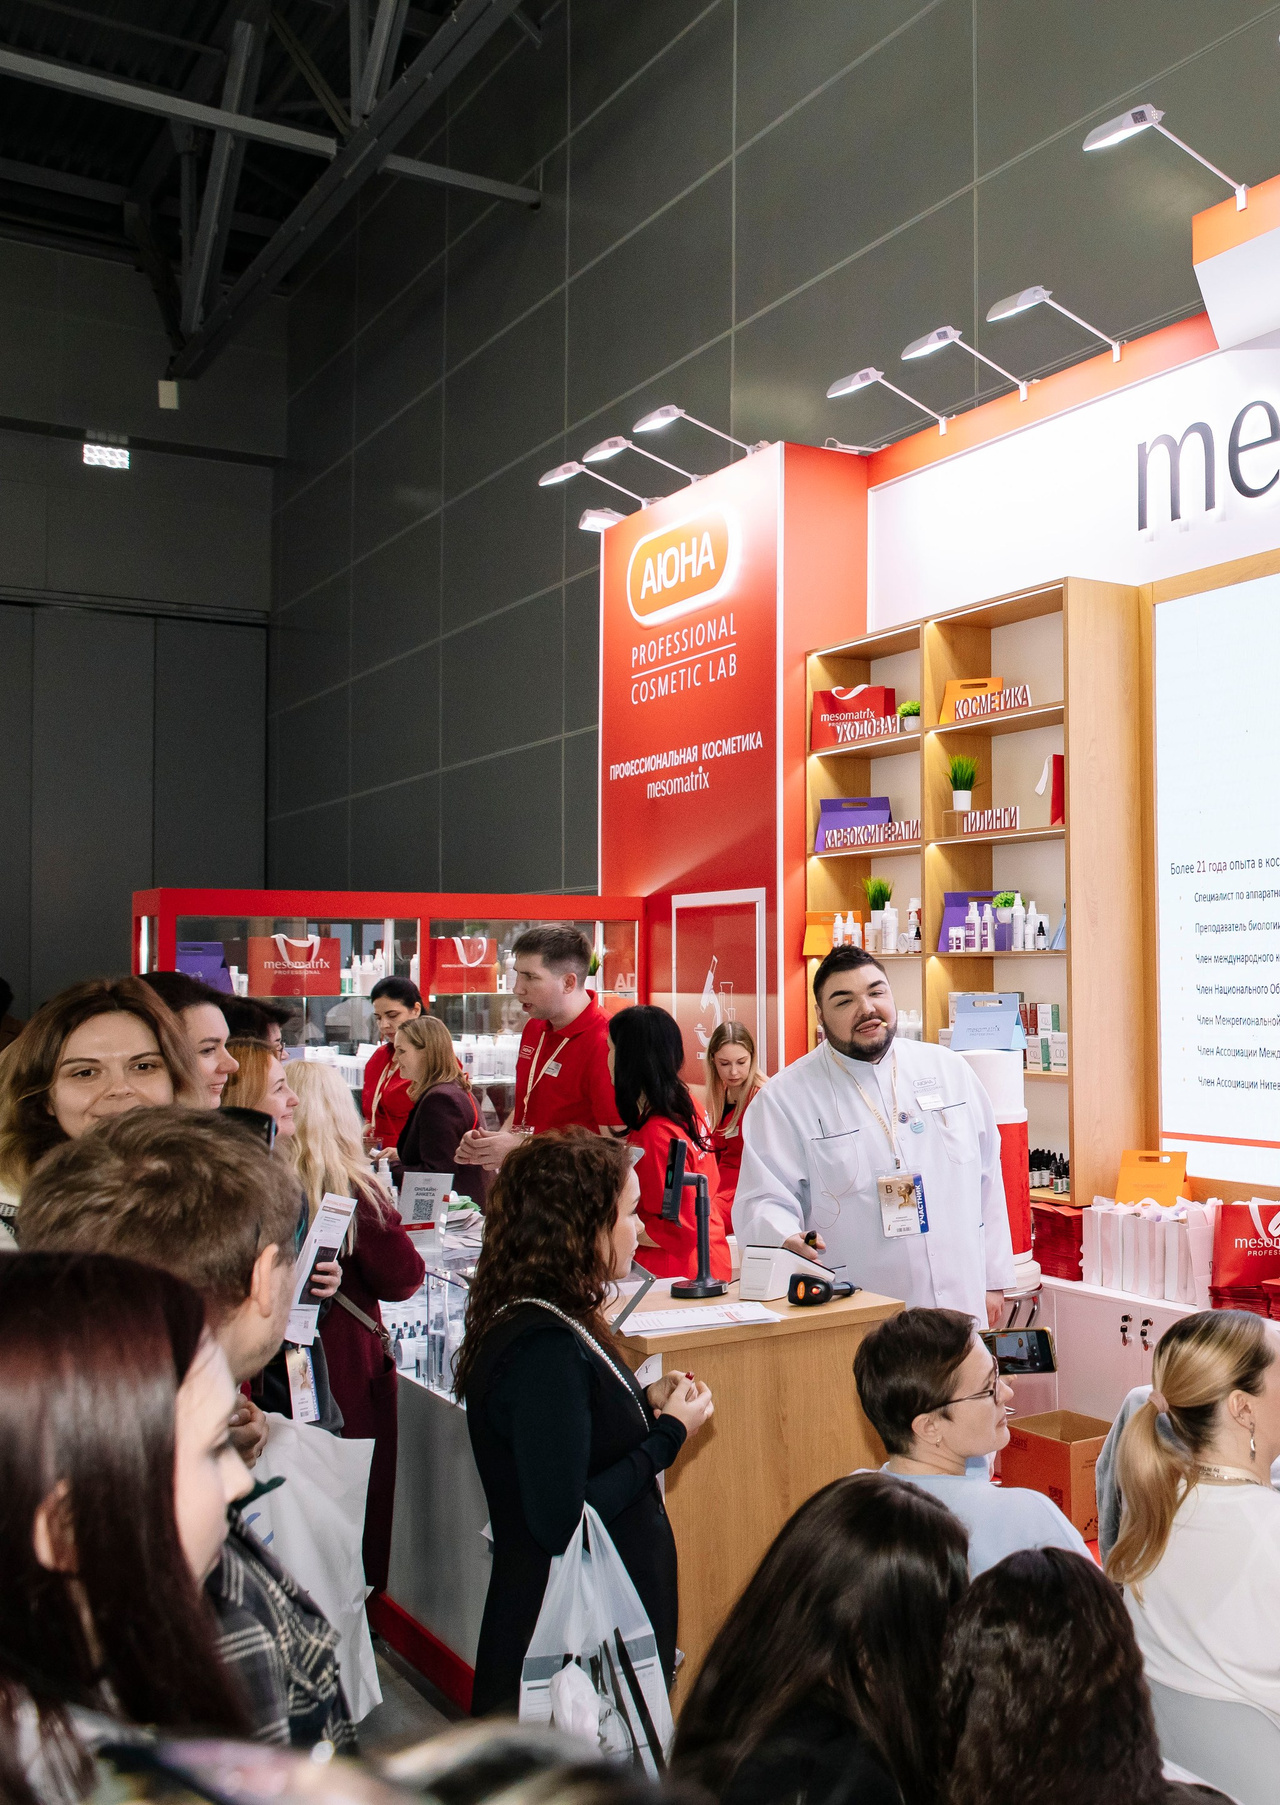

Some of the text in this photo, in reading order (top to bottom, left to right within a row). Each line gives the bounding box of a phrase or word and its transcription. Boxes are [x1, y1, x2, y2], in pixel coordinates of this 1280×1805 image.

[640, 531, 716, 600] АЮНА
[631, 612, 738, 669] PROFESSIONAL
[631, 653, 738, 705] COSMETIC LAB
[955, 684, 1032, 721] КОСМЕТИКА
[820, 708, 875, 722] mesomatrix
[836, 714, 901, 743] УХОДОВАЯ
[609, 731, 763, 781] ПРОФЕССИОНАЛЬНАЯ КОСМЕТИКА
[646, 765, 710, 799] mesomatrix
[963, 806, 1020, 834] ПИЛИНГИ
[825, 819, 921, 849] КАРБОКСИТЕРАПИ
[1170, 862, 1195, 875] Более
[1196, 860, 1206, 873] 21
[1208, 861, 1227, 874] года
[1229, 858, 1256, 871] опыта
[1258, 858, 1263, 868] в
[1194, 890, 1234, 903] Специалист
[1235, 891, 1244, 900] по
[1194, 921, 1247, 935] Преподаватель
[263, 957, 331, 970] mesomatrix
[1196, 953, 1212, 964] Член
[1213, 952, 1274, 967] международного
[1196, 984, 1213, 995] Член
[1214, 984, 1269, 996] Национального
[1197, 1014, 1214, 1025] Член
[1215, 1014, 1280, 1028] Межрегиональной
[1197, 1045, 1214, 1056] Член
[1216, 1046, 1258, 1059] Ассоциации
[1198, 1076, 1215, 1087] Член
[1216, 1077, 1259, 1089] Ассоциации
[914, 1184, 926, 1225] УЧАСТНИК
